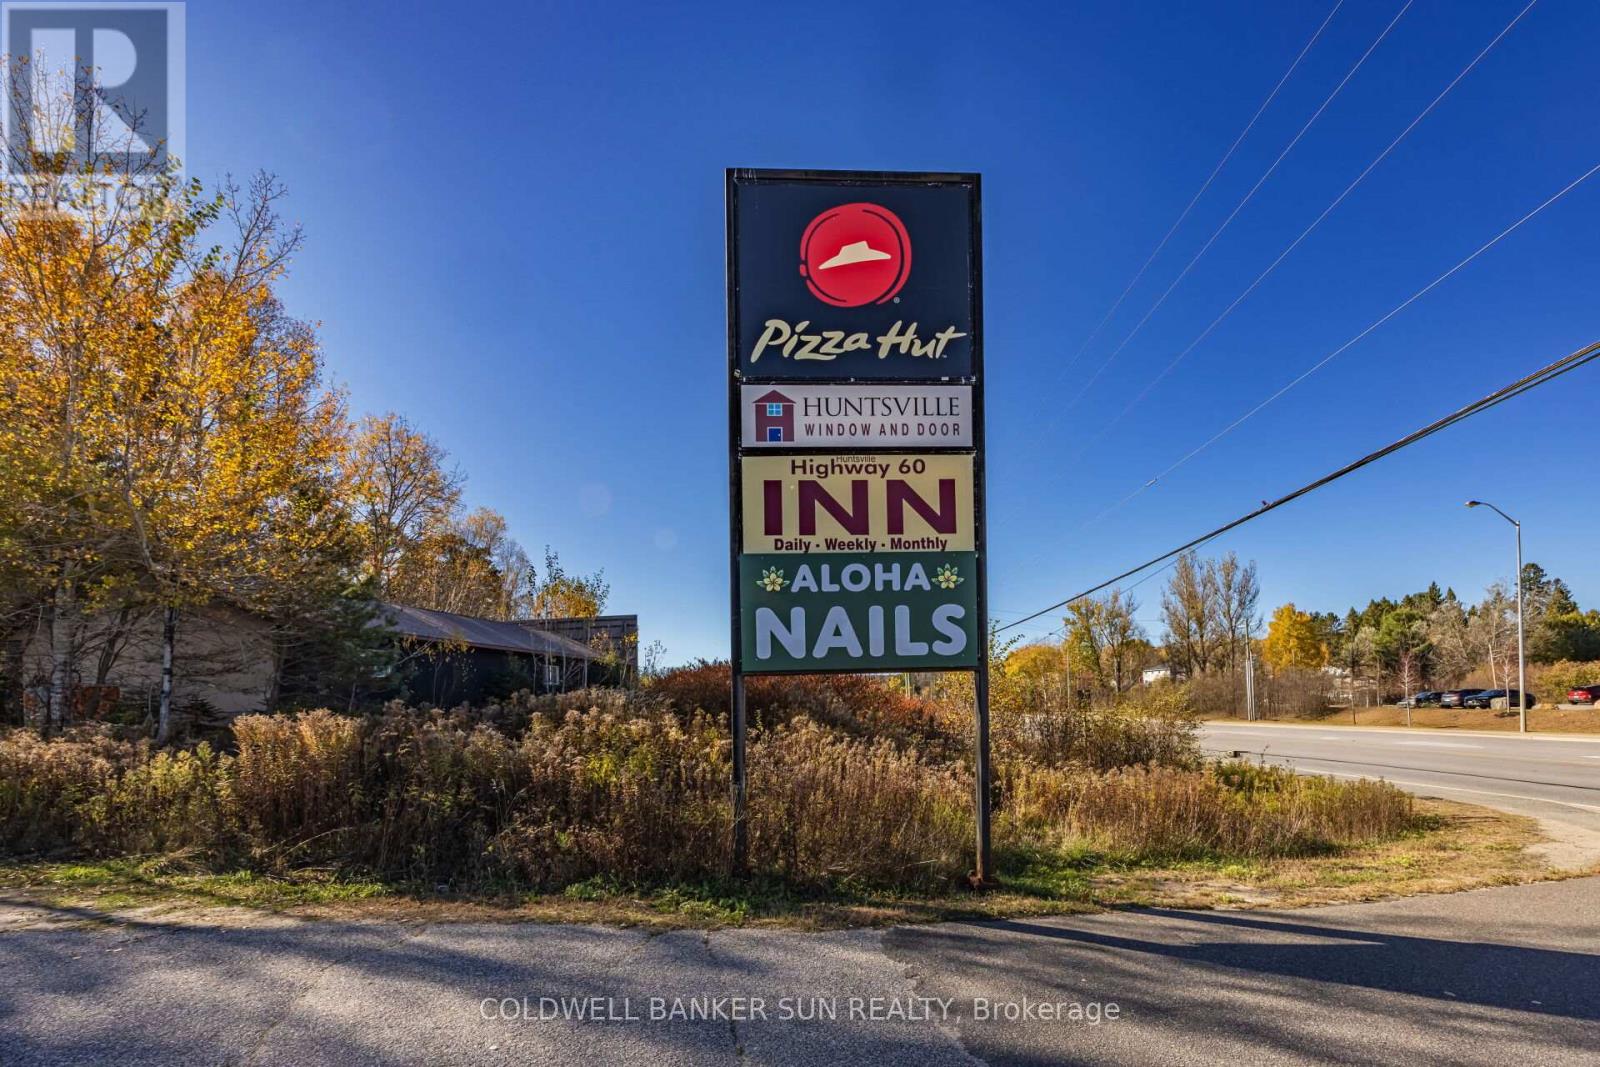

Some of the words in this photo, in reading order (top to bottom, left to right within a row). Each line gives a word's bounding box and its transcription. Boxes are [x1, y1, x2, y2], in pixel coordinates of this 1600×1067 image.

[751, 319, 871, 363] Pizza
[877, 320, 967, 359] Hut
[803, 397, 960, 417] HUNTSVILLE
[805, 423, 871, 436] WINDOW
[880, 423, 909, 436] AND
[917, 423, 960, 436] DOOR
[791, 458, 890, 479] Highway
[898, 458, 926, 474] 60
[836, 455, 876, 463] Huntsville
[763, 479, 957, 536] INN
[774, 538, 811, 554] Daily
[825, 538, 877, 553] Weekly
[890, 537, 948, 551] Monthly
[791, 562, 931, 593] ALOHA
[755, 603, 968, 660] NAILS
